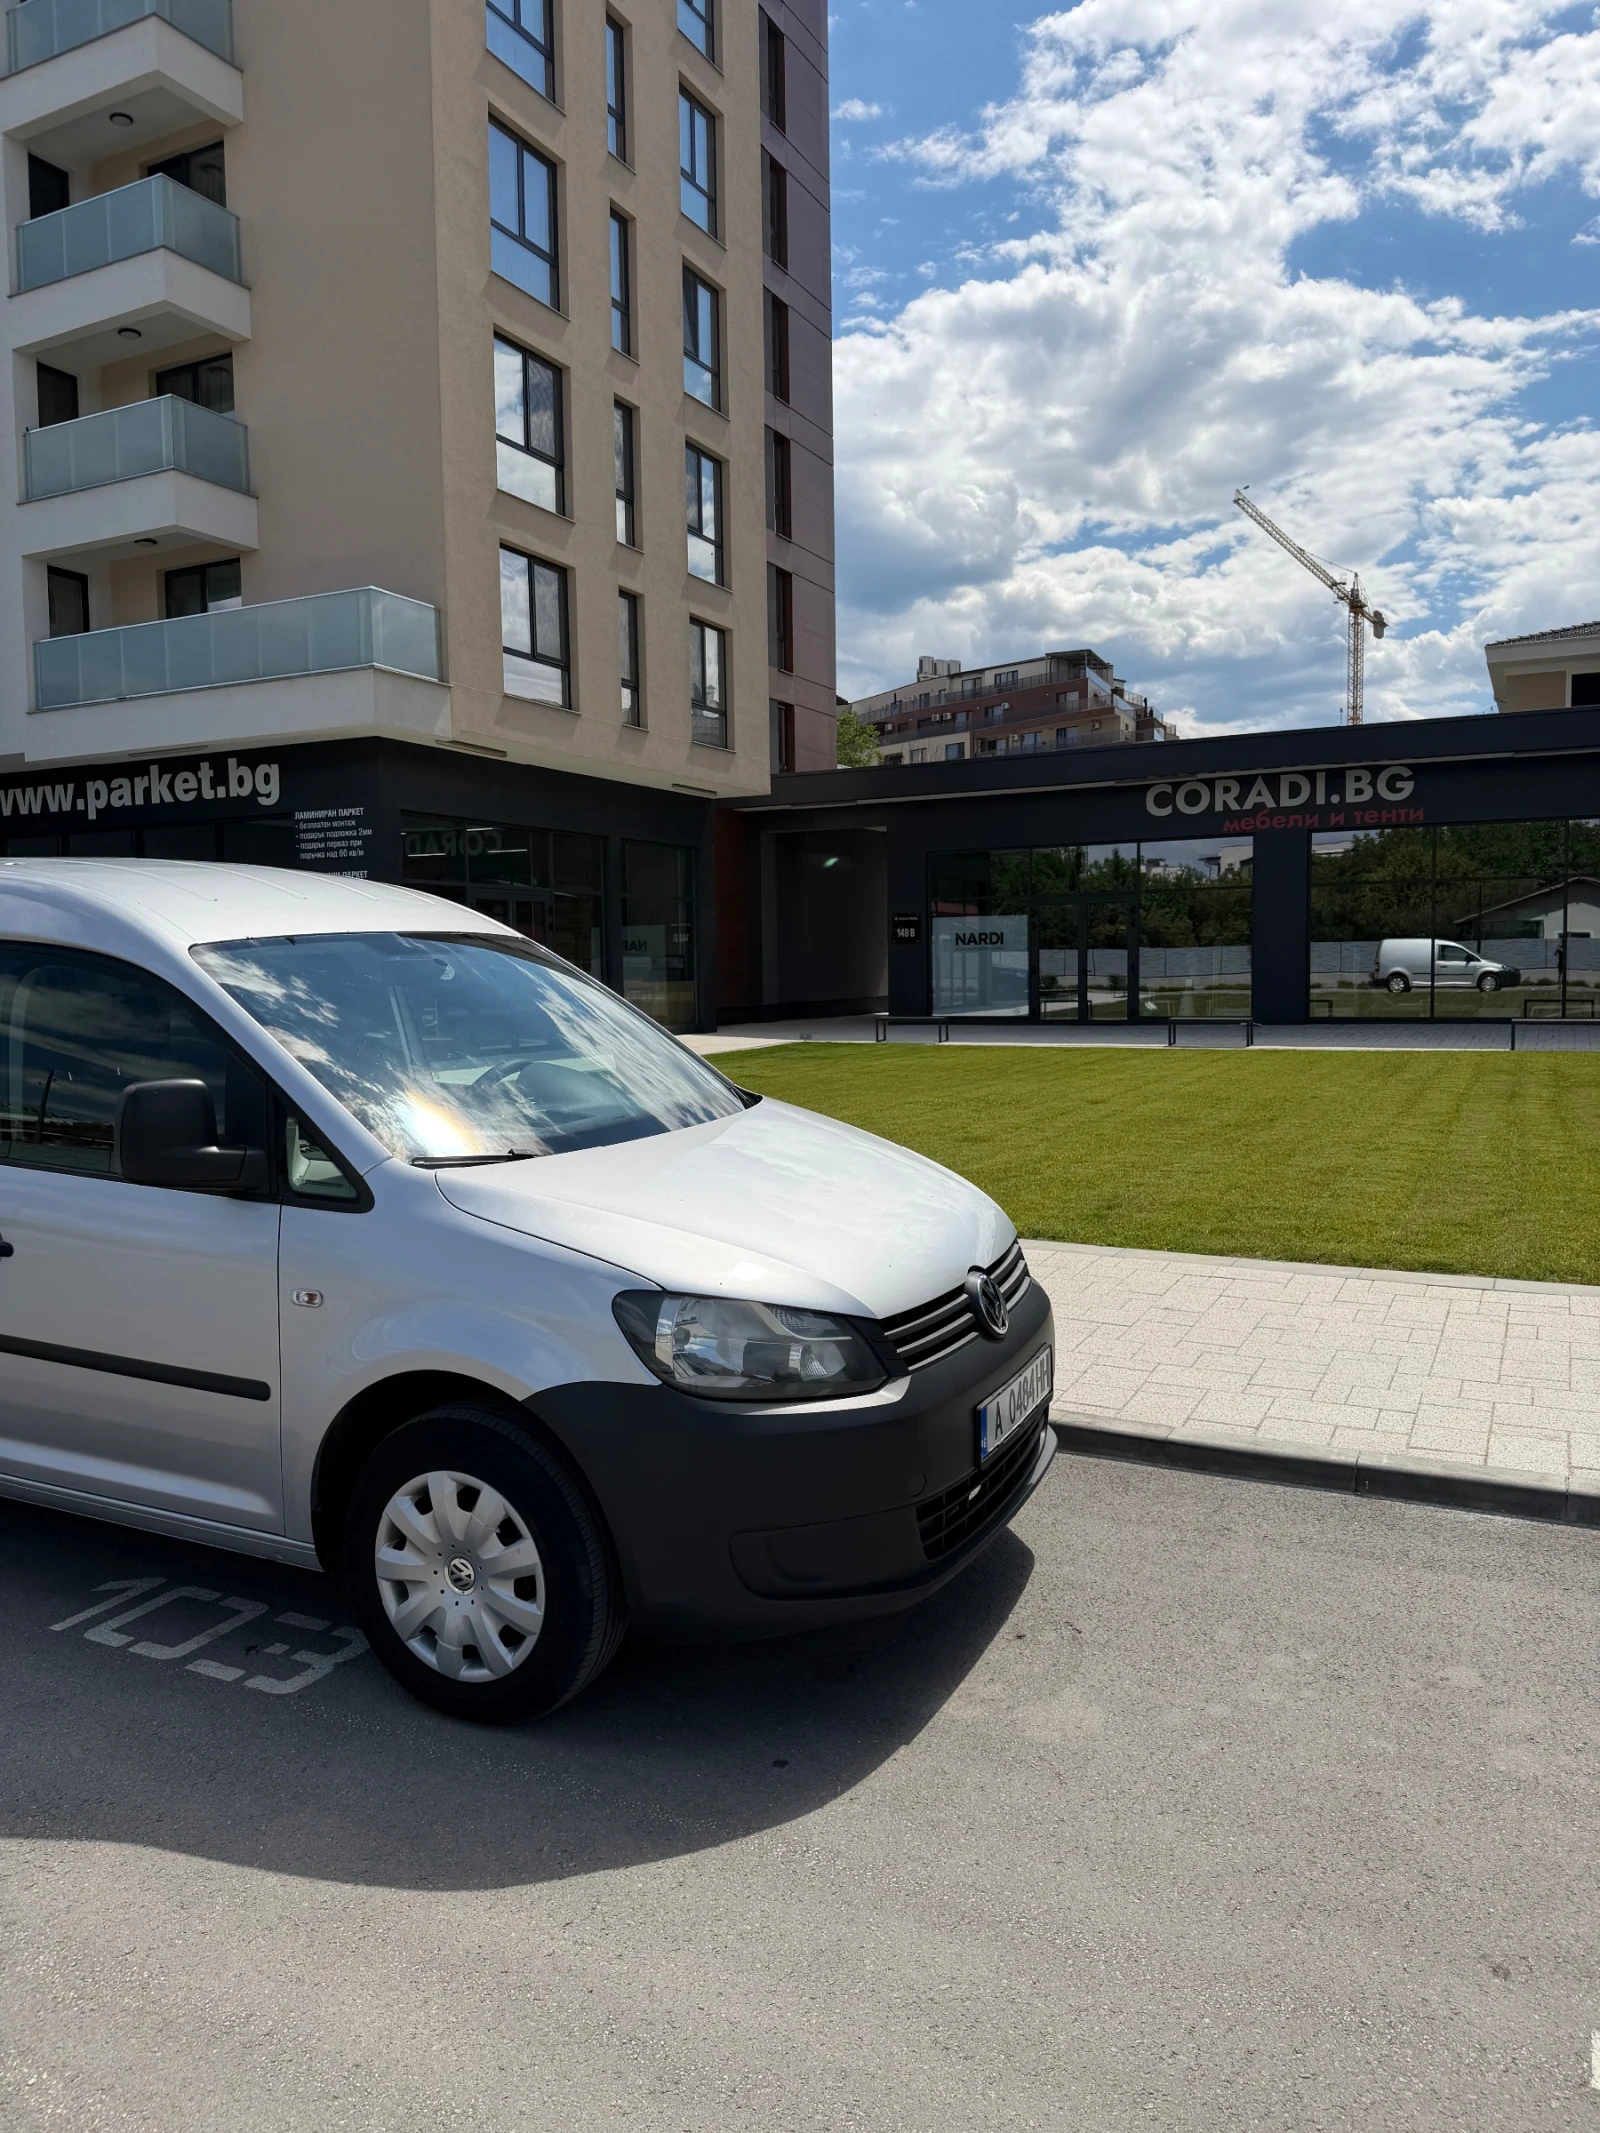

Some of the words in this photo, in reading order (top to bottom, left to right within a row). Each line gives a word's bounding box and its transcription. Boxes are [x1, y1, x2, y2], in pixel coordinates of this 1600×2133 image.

[1145, 766, 1415, 816] CORADI.BG
[294, 809, 337, 820] ЛАМИНИРАН
[338, 807, 364, 817] ПАРКЕТ
[1223, 808, 1319, 831] мебели
[1330, 811, 1344, 825] и
[1353, 808, 1424, 824] тенти
[299, 821, 331, 830] безплатен
[332, 819, 356, 827] монтаж
[358, 827, 372, 836] 2мм
[349, 839, 362, 847] при
[326, 850, 338, 858] над
[338, 849, 348, 857] 60
[896, 927, 909, 938] 148
[955, 932, 1004, 945] NARDI
[48, 1577, 373, 1694] 103
